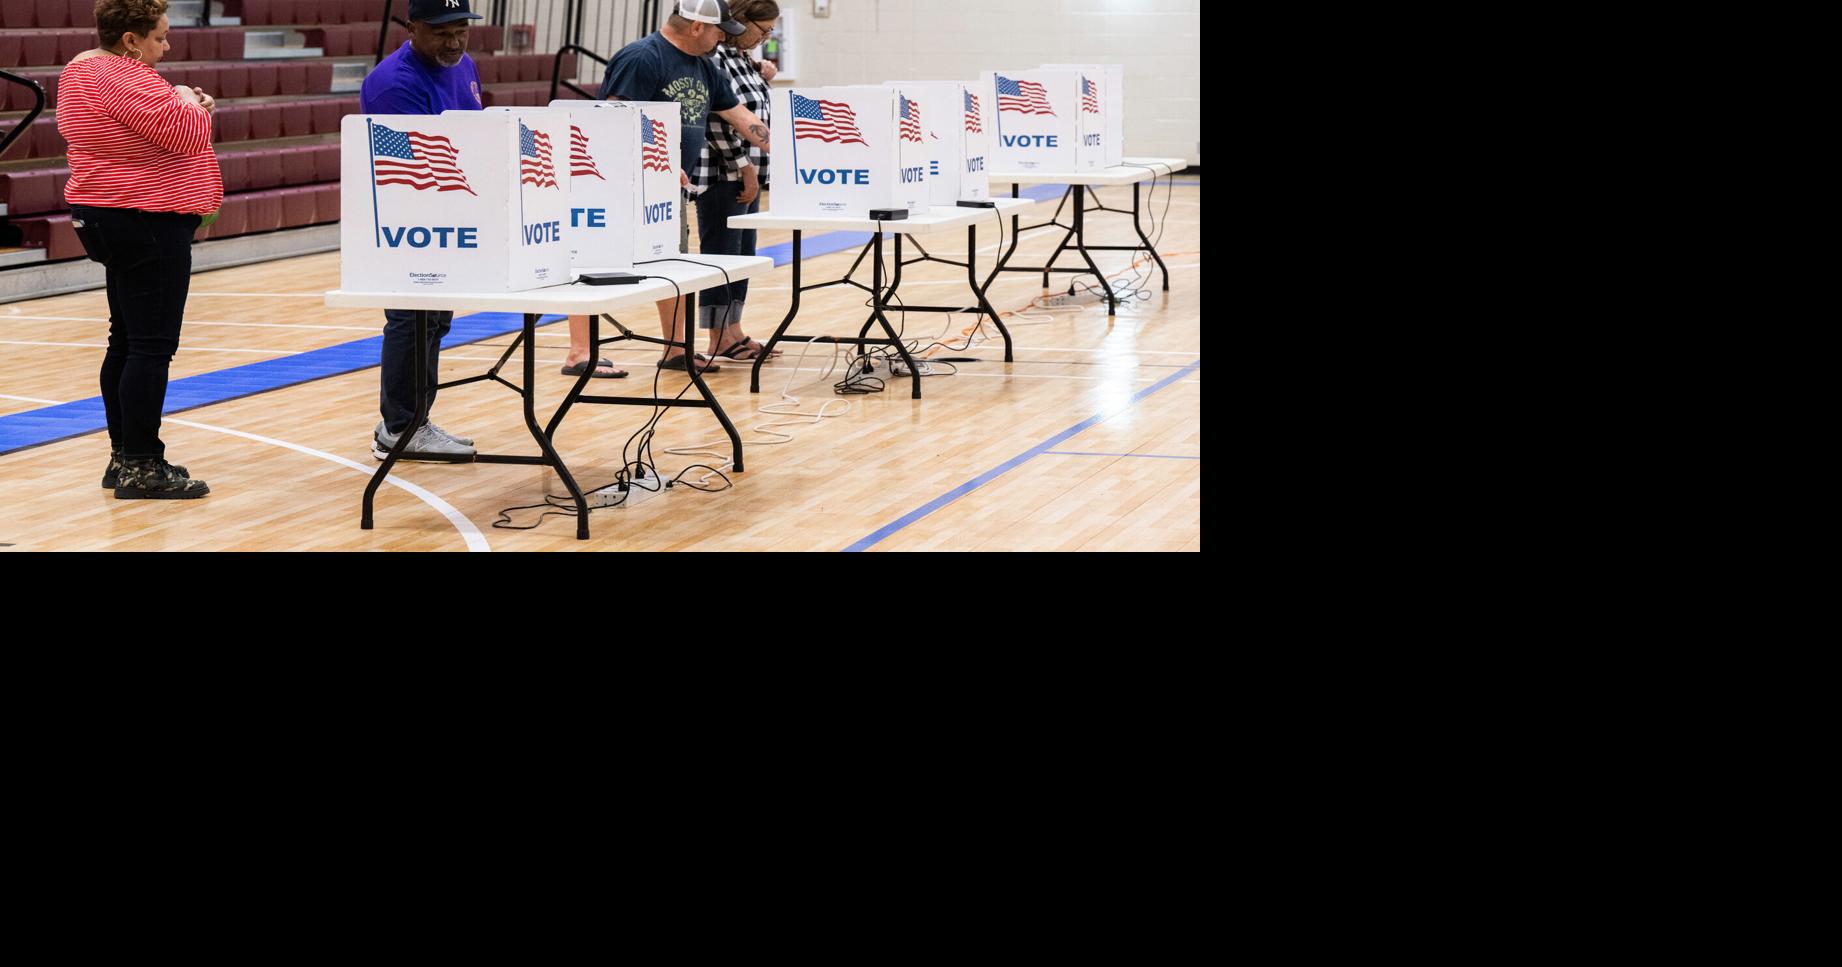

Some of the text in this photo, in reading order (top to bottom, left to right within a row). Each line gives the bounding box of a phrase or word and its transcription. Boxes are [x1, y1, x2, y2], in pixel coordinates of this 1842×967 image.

[661, 76, 694, 97] MOSSY
[1002, 134, 1058, 148] VOTE
[1083, 133, 1100, 147] VOTE
[967, 156, 984, 173] VOTE
[799, 168, 870, 185] VOTE
[901, 166, 924, 184] VOTE
[570, 207, 606, 228] TE
[645, 201, 673, 225] VOTE
[382, 226, 478, 249] VOTE
[524, 220, 560, 246] VOTE
